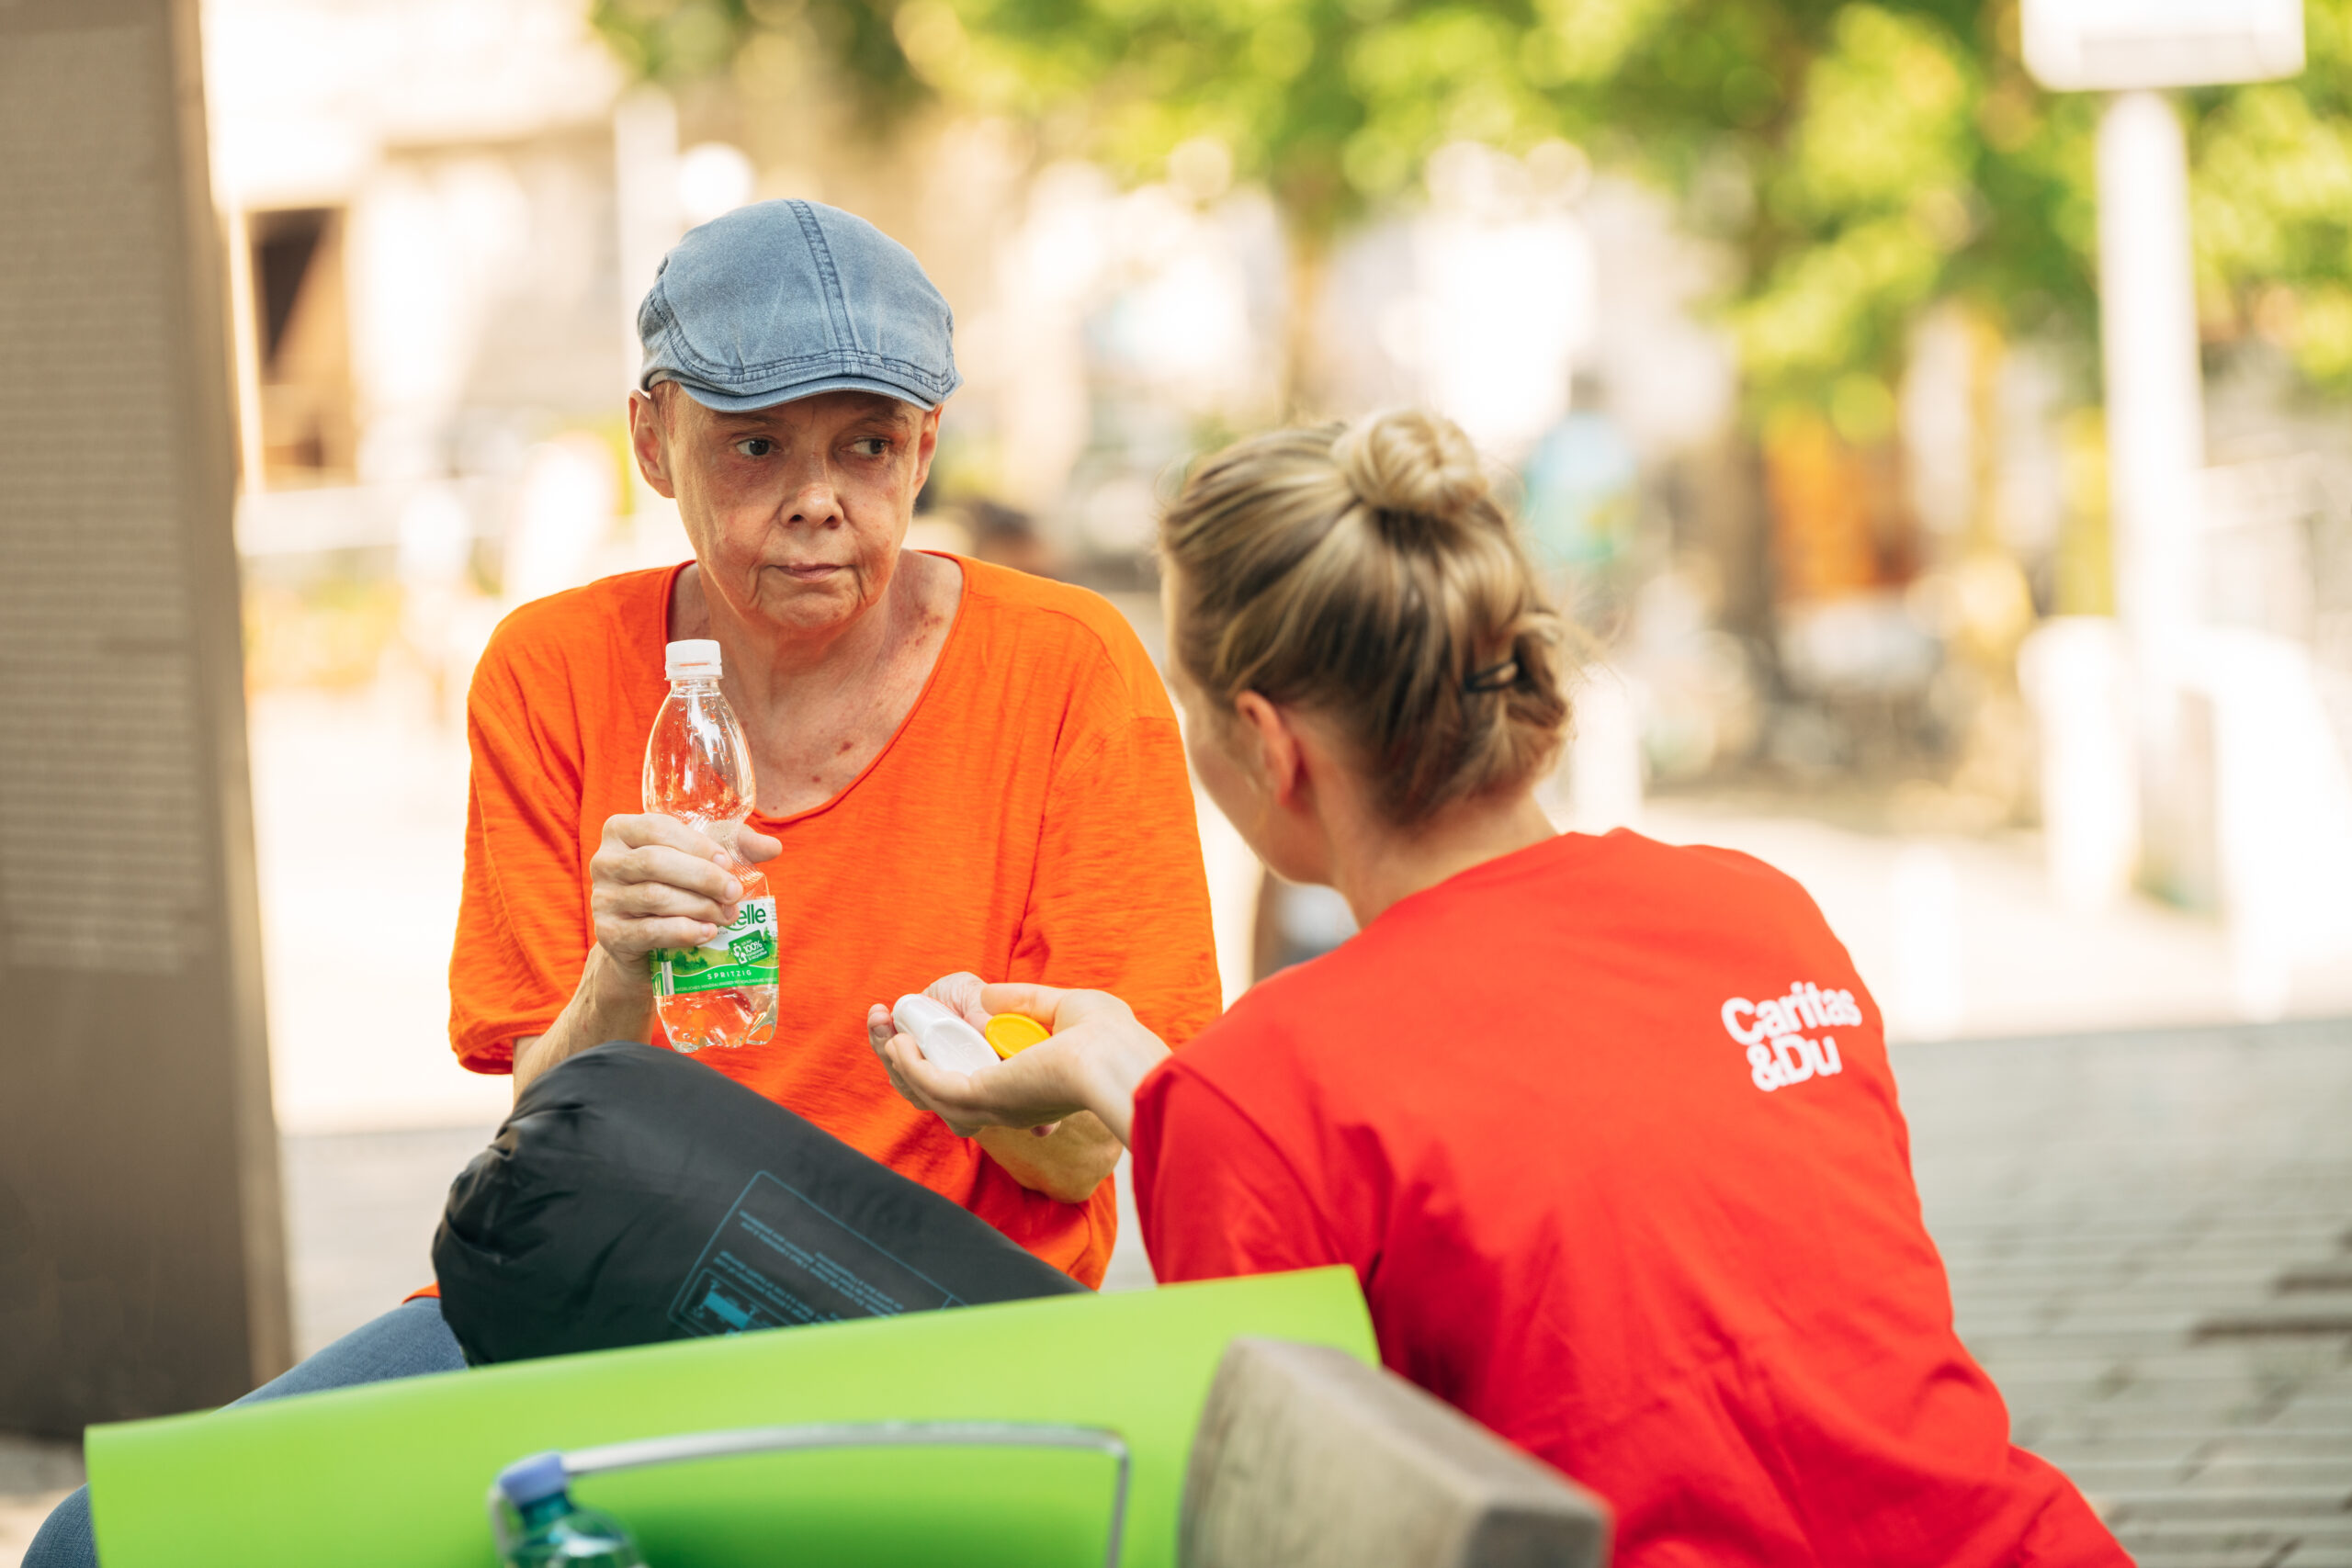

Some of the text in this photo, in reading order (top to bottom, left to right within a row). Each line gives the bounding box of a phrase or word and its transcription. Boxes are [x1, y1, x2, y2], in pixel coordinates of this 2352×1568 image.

[743, 940, 763, 953] 100%
[707, 970, 752, 979] SPRITZIG
[1721, 981, 1862, 1046] Caritas
[1747, 1035, 1842, 1092] &Du
